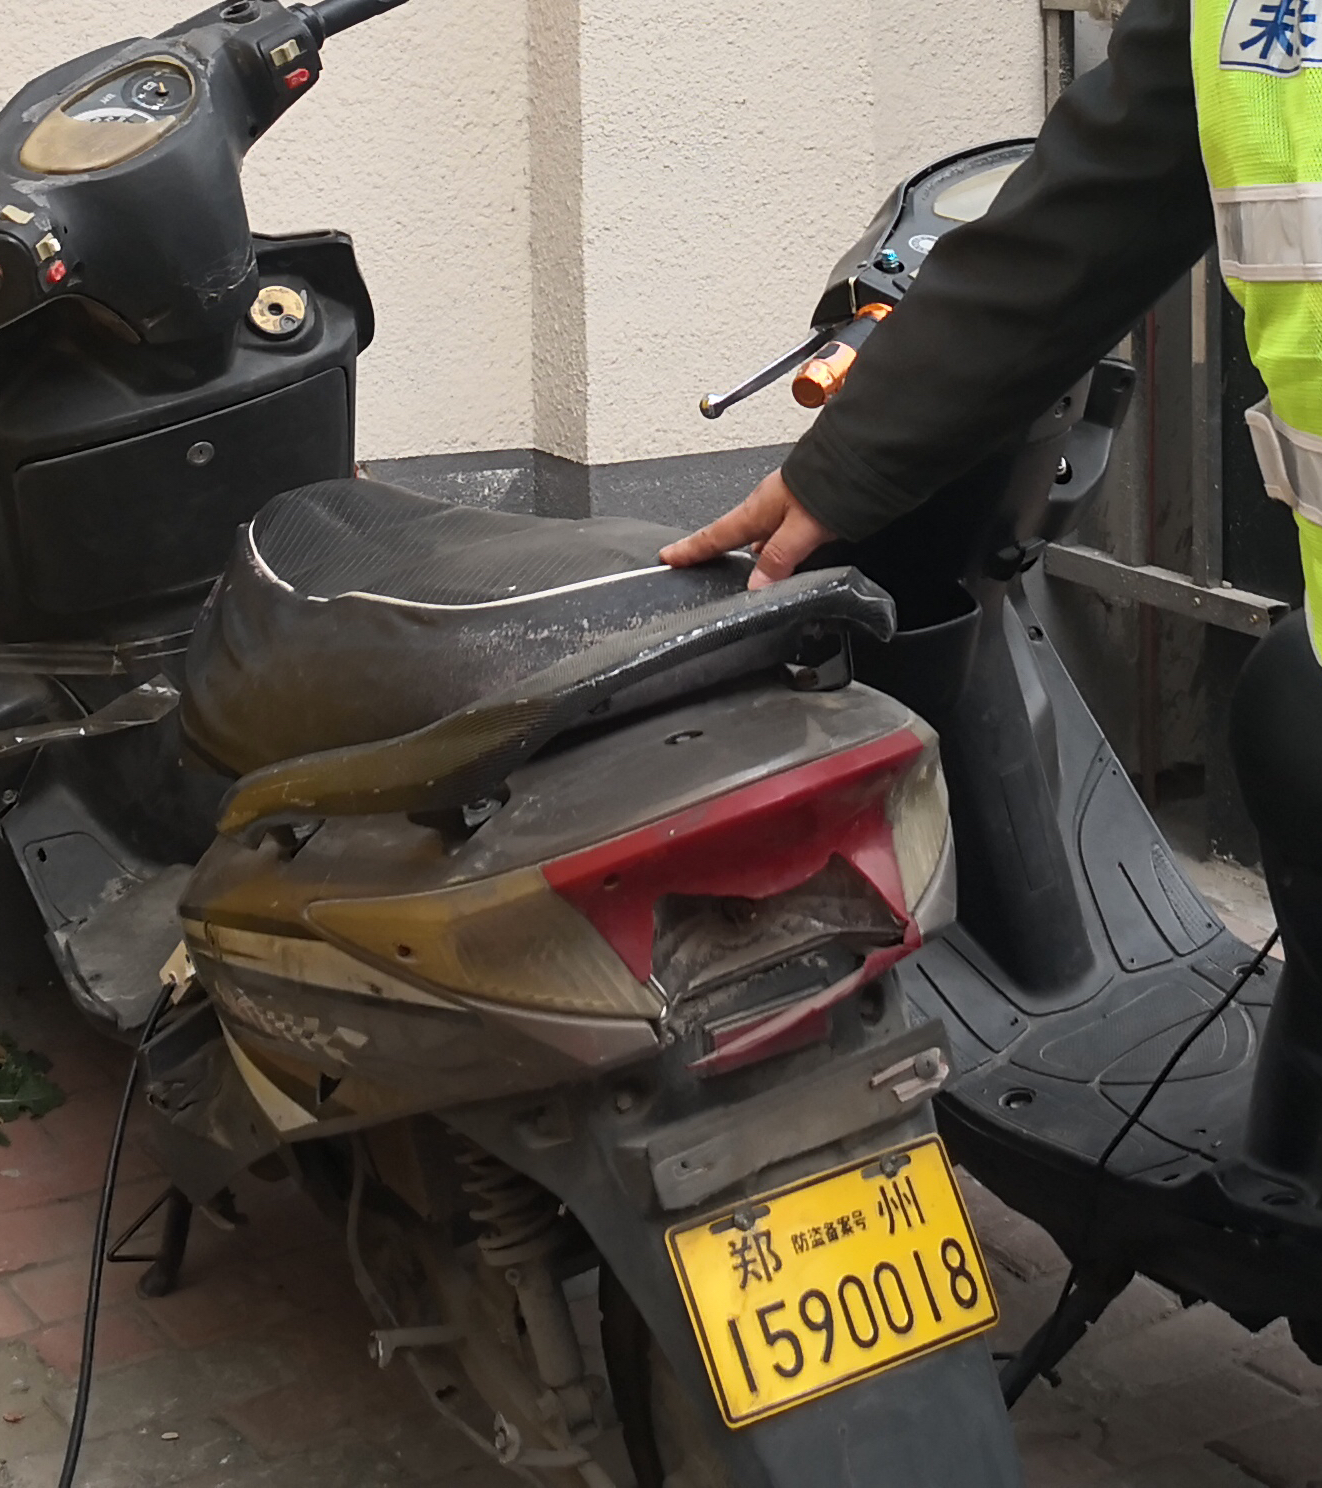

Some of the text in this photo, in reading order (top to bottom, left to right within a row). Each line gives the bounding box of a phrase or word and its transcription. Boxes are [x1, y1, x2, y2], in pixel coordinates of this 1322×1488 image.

[728, 1175, 926, 1290] 郑 防盗备案号 州
[727, 1236, 979, 1394] 1590018
